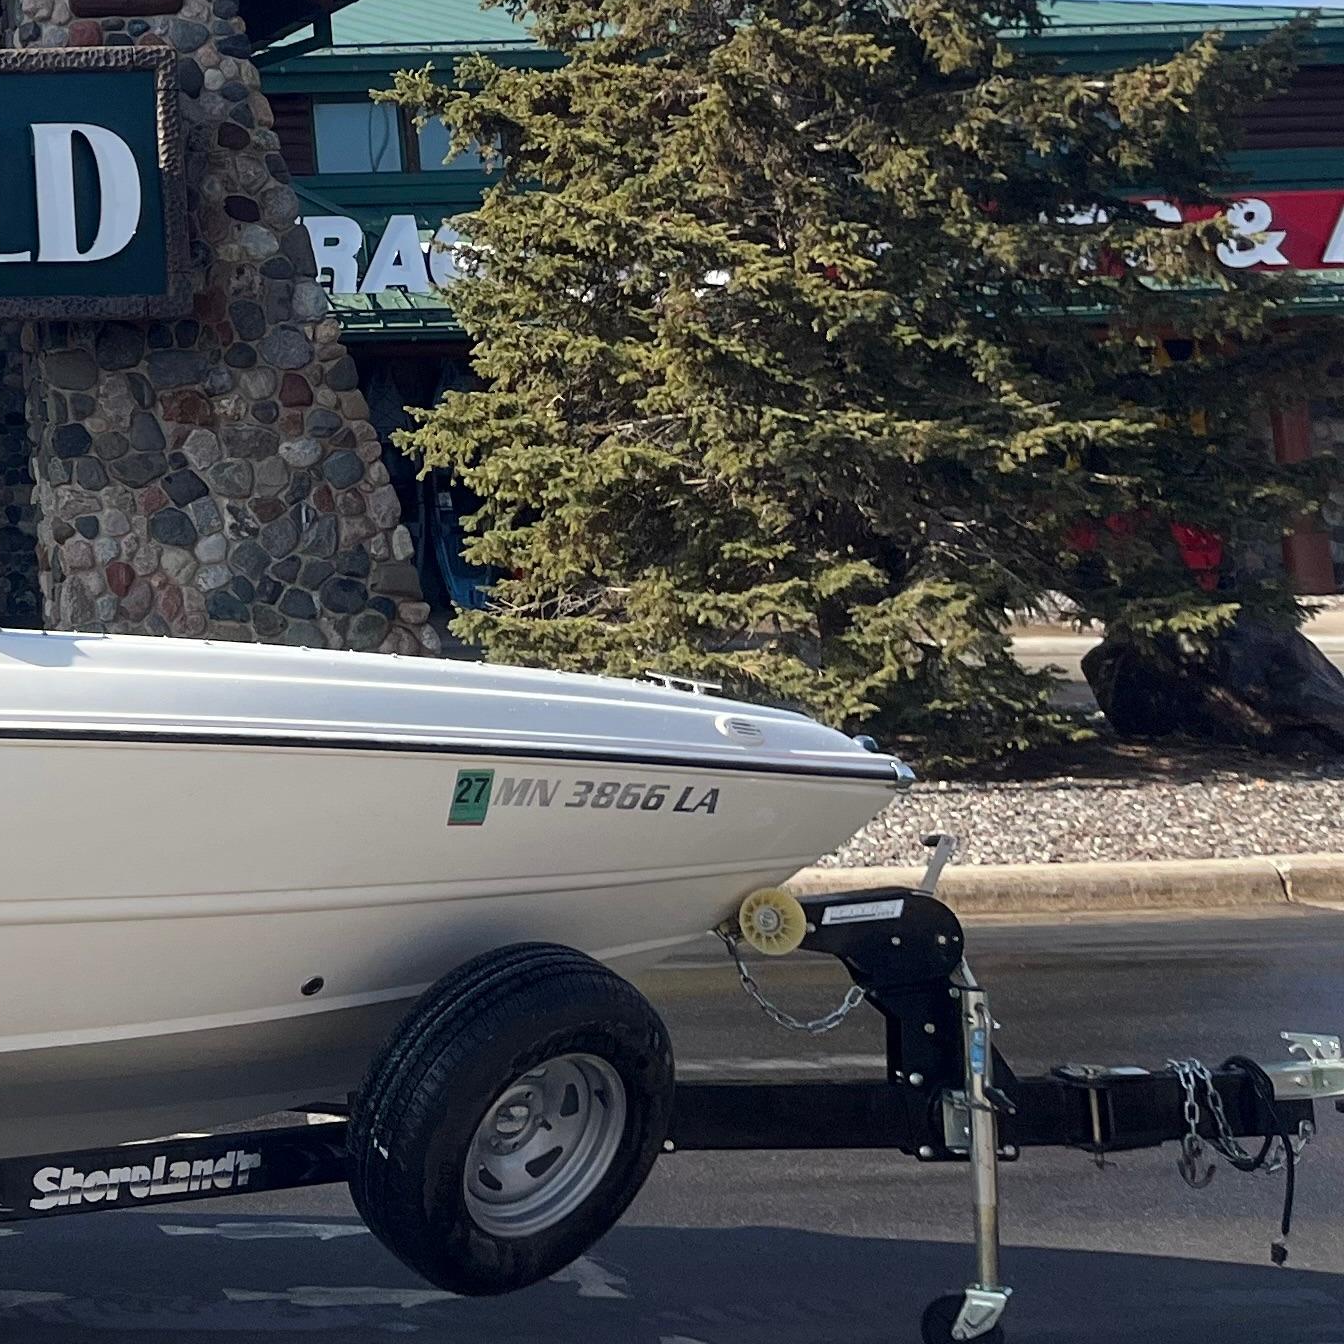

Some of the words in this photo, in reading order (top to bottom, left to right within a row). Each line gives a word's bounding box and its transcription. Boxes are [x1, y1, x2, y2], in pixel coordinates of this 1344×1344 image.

[456, 777, 490, 804] 27
[493, 777, 561, 807] MN
[564, 780, 670, 811] 3866
[672, 786, 720, 814] LA
